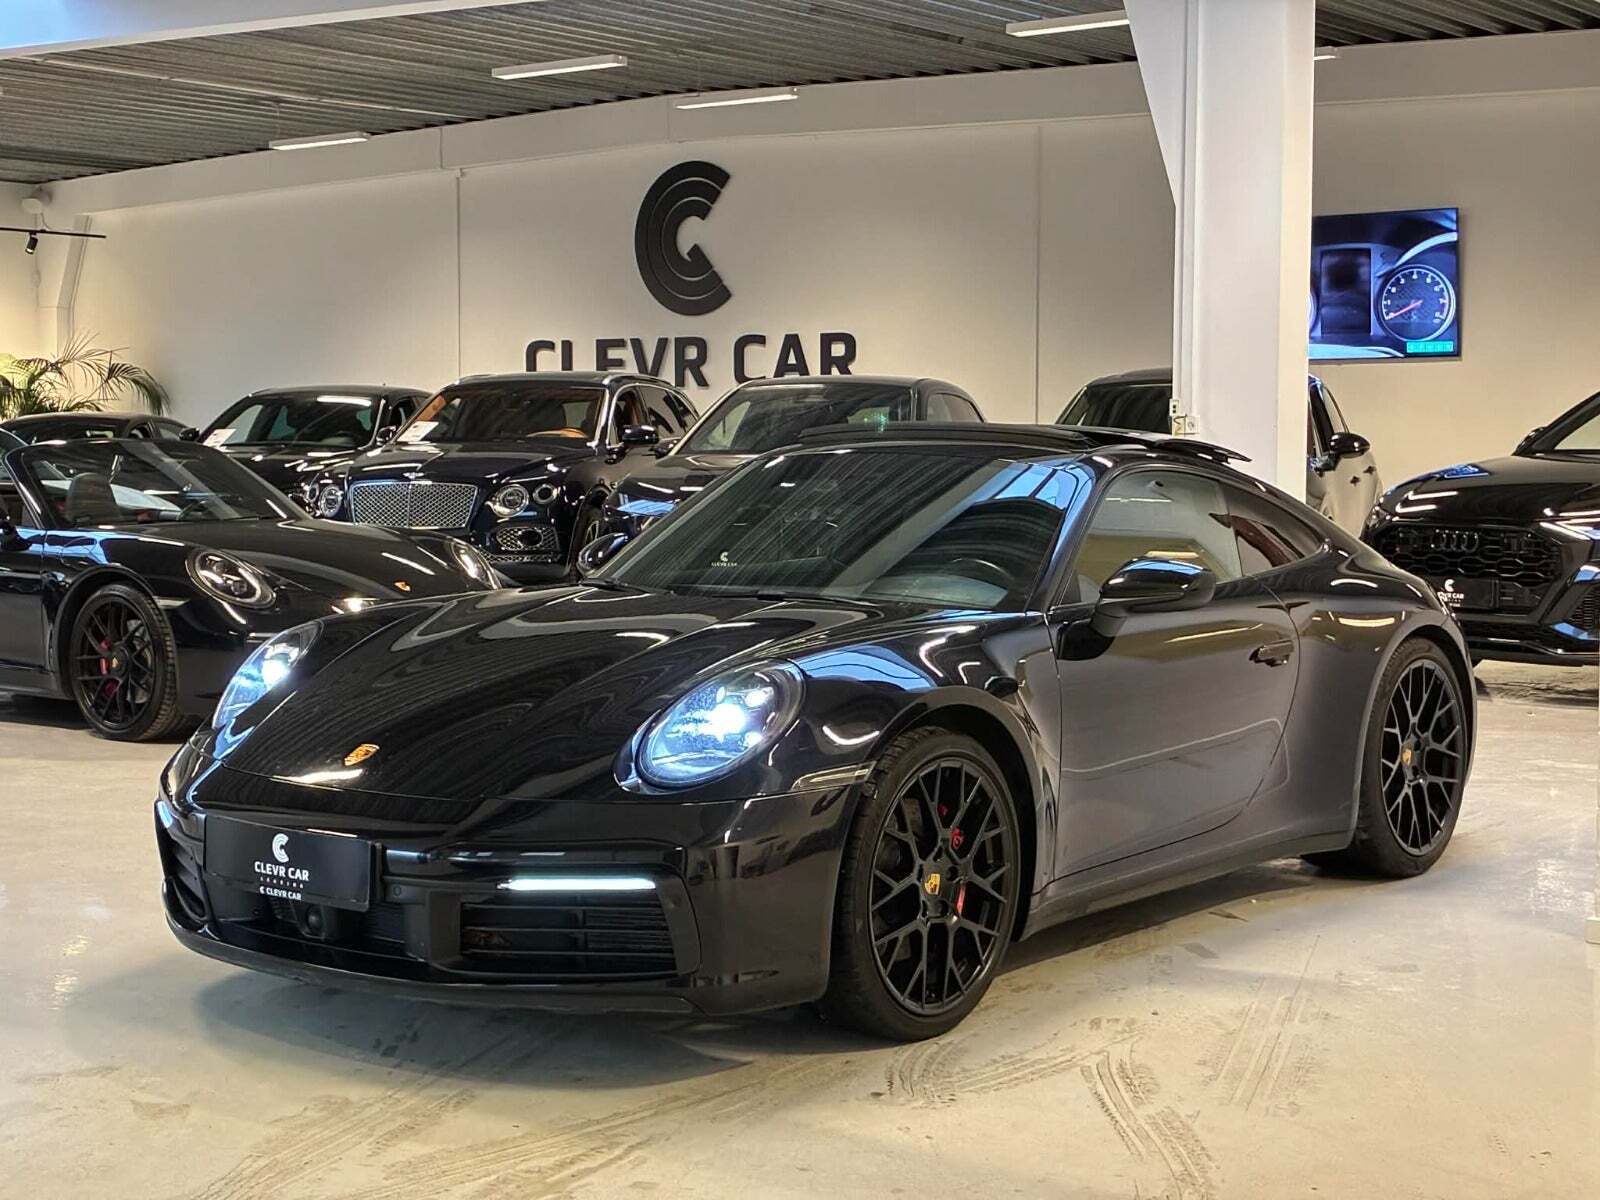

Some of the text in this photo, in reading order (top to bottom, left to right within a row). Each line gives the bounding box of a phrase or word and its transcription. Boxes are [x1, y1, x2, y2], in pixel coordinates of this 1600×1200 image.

[733, 332, 857, 384] CAR
[254, 861, 310, 882] CLEVR CAR
[266, 887, 287, 898] CLEVR
[288, 891, 302, 901] CAR
